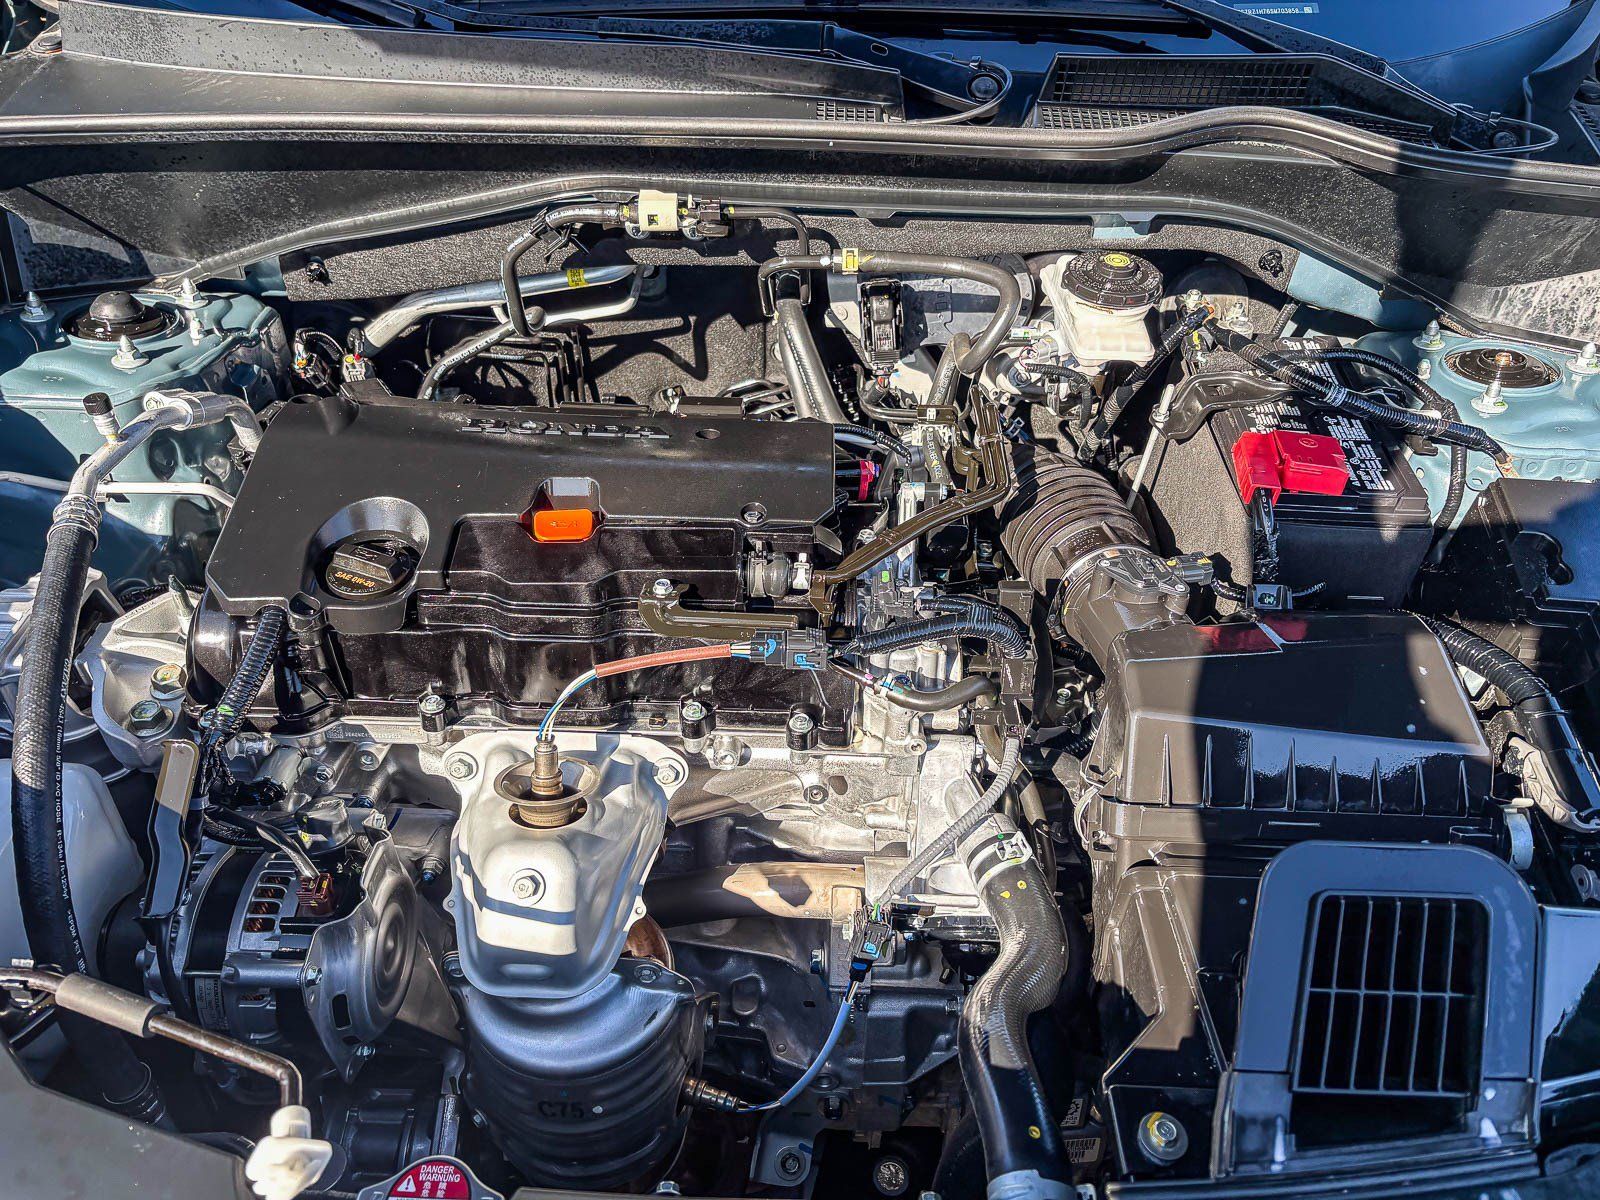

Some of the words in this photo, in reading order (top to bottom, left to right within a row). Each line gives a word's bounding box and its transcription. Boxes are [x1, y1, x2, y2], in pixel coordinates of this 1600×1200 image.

[460, 417, 671, 440] HONDA
[334, 571, 353, 581] SAE
[351, 576, 376, 588] 0W-20
[420, 1164, 455, 1174] DANGER
[418, 1172, 461, 1183] WARNUNG
